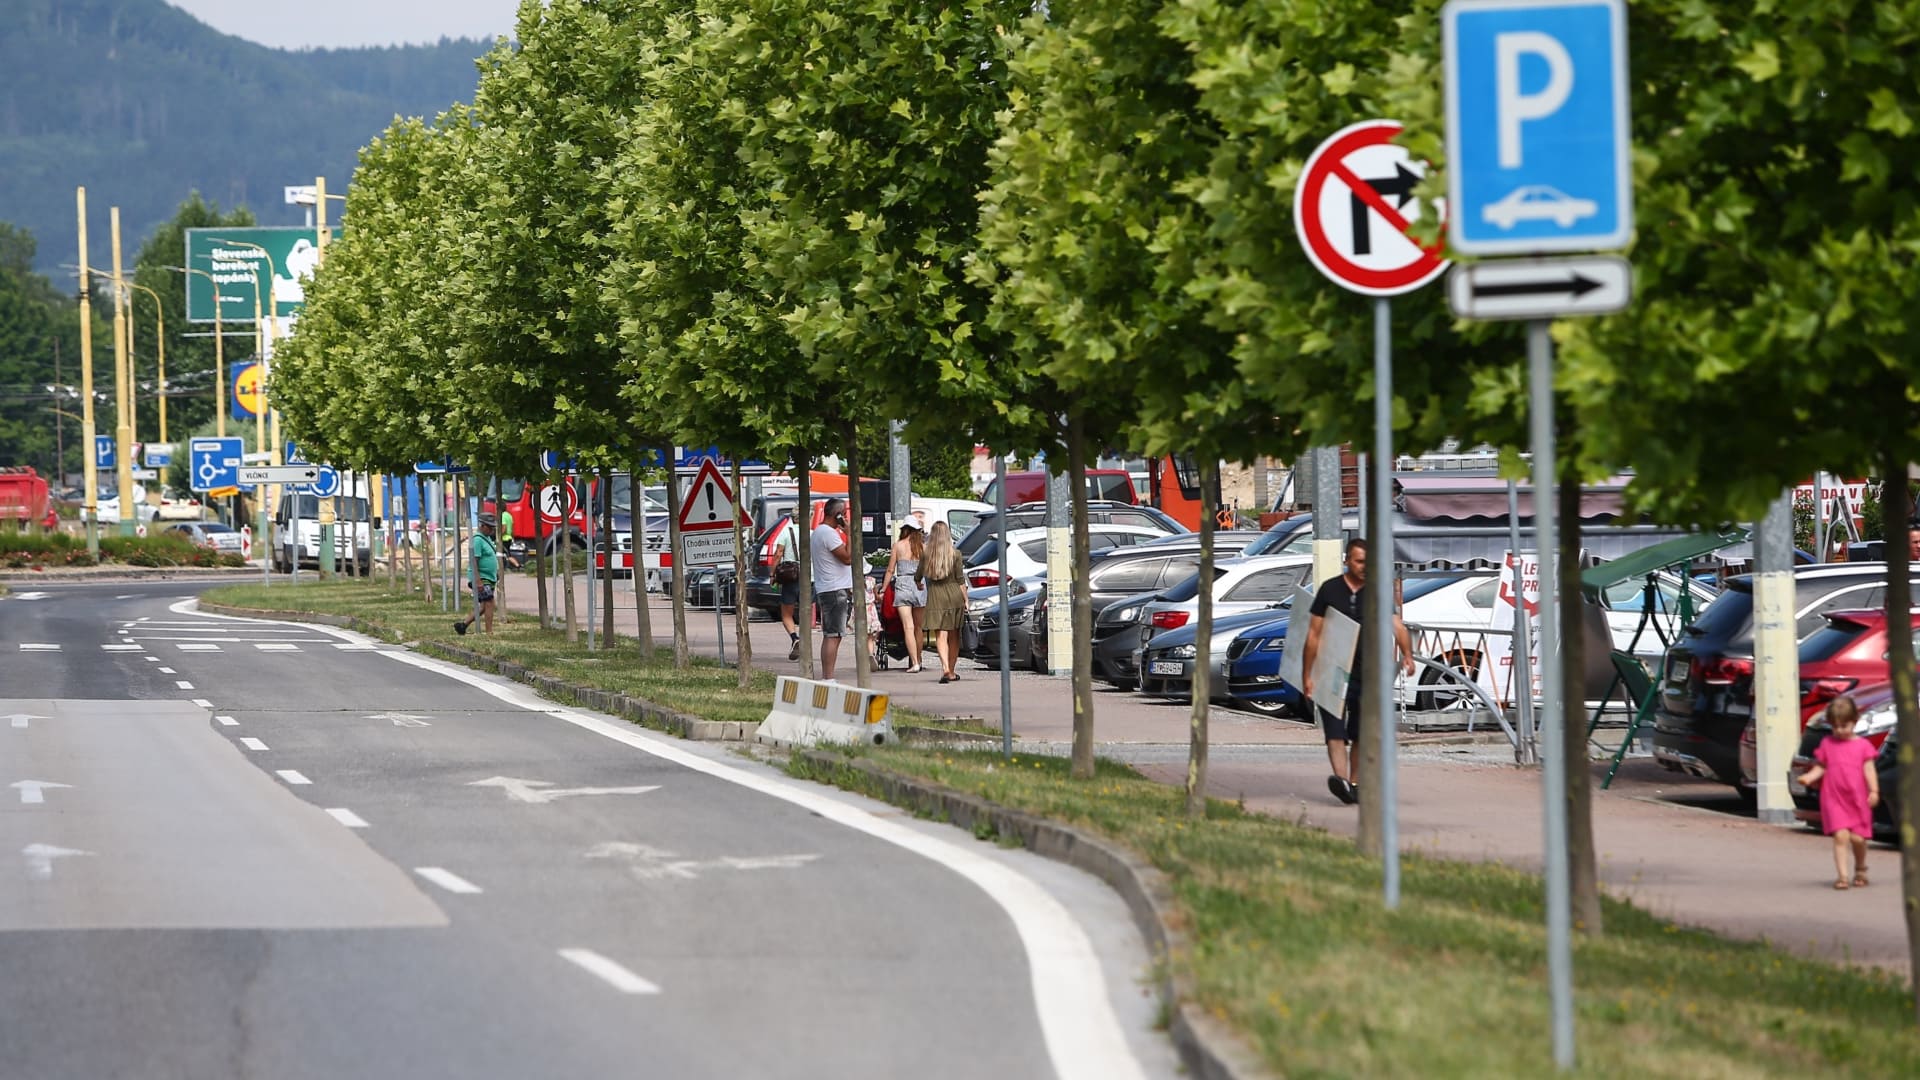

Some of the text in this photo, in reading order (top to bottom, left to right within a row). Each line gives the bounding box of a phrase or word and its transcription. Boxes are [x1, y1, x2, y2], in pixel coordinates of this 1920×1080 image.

[1495, 31, 1575, 169] P
[711, 536, 735, 546] uzavret
[709, 549, 733, 558] centrum
